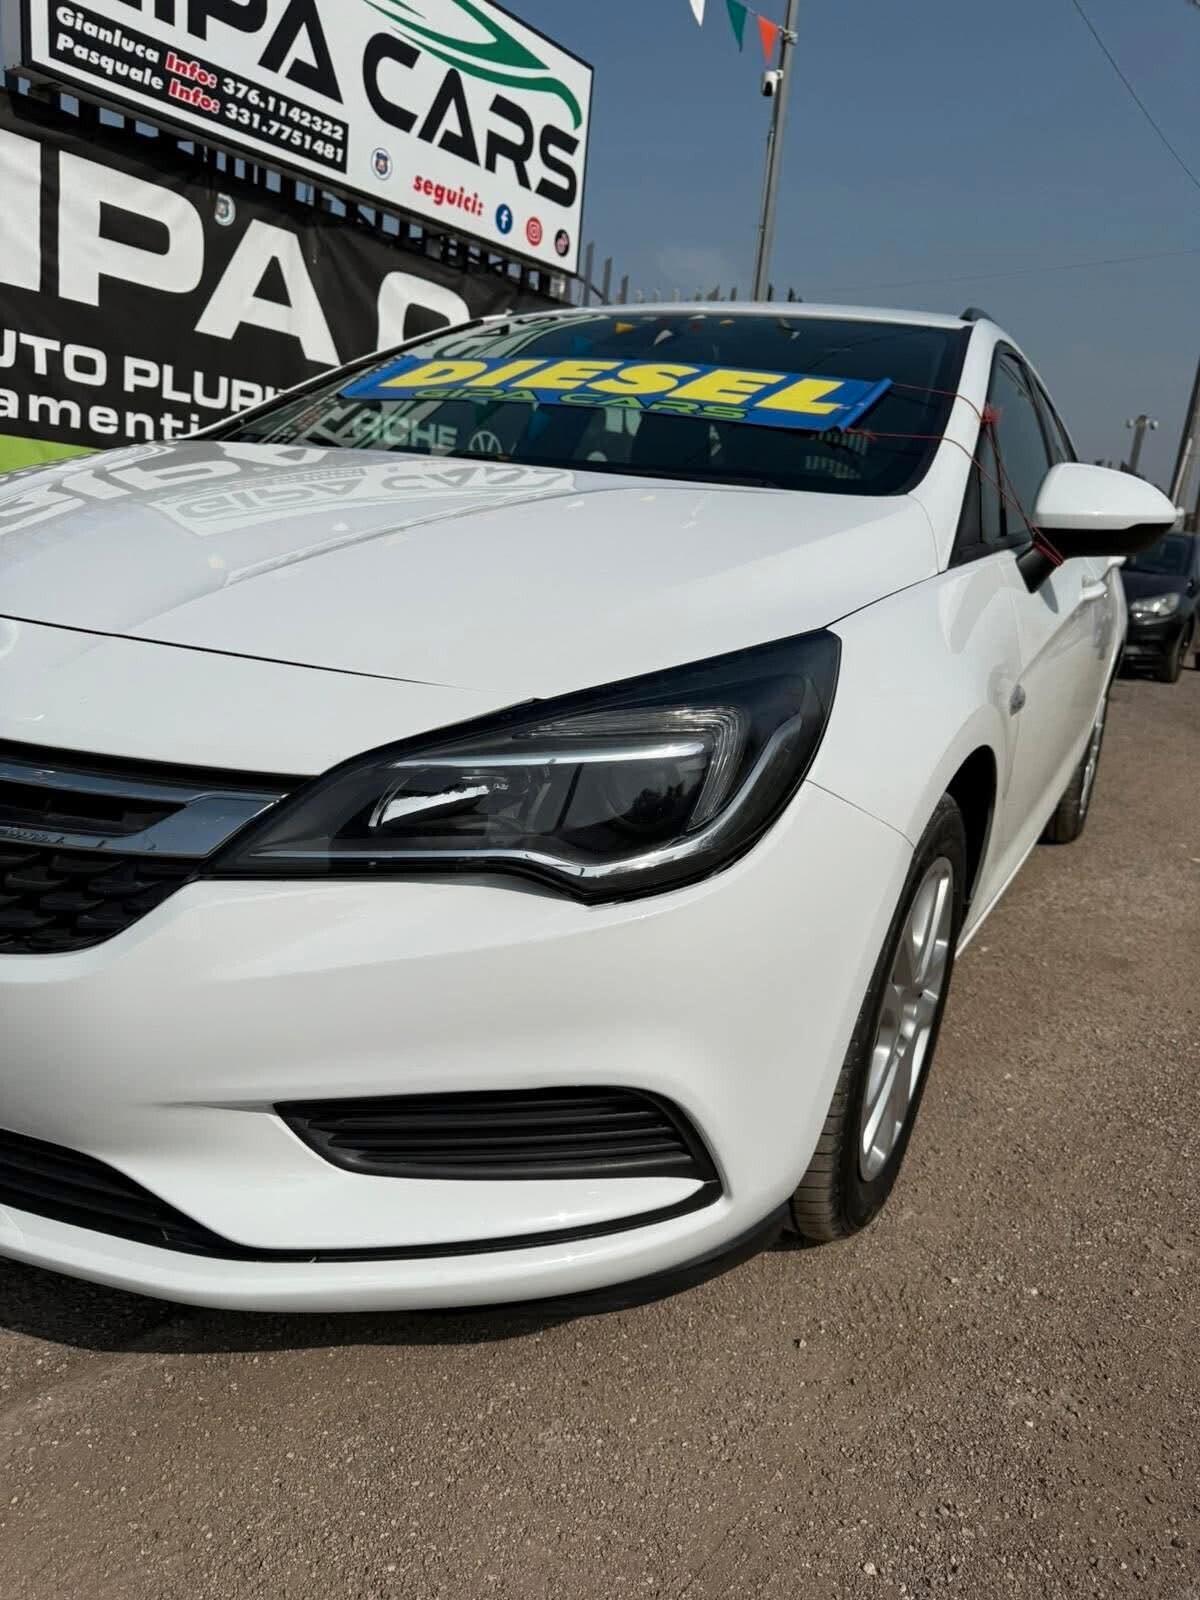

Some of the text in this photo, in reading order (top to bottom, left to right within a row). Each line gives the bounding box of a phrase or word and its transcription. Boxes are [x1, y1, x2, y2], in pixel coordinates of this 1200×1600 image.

[56, 6, 344, 140] Gianluca Info: 376.1142322
[56, 34, 344, 163] Pasquale Info: 331.7751481
[363, 32, 580, 208] CARS
[412, 174, 484, 217] seguici:
[380, 359, 845, 415] DIESEL
[415, 388, 749, 419] GIPA CARS
